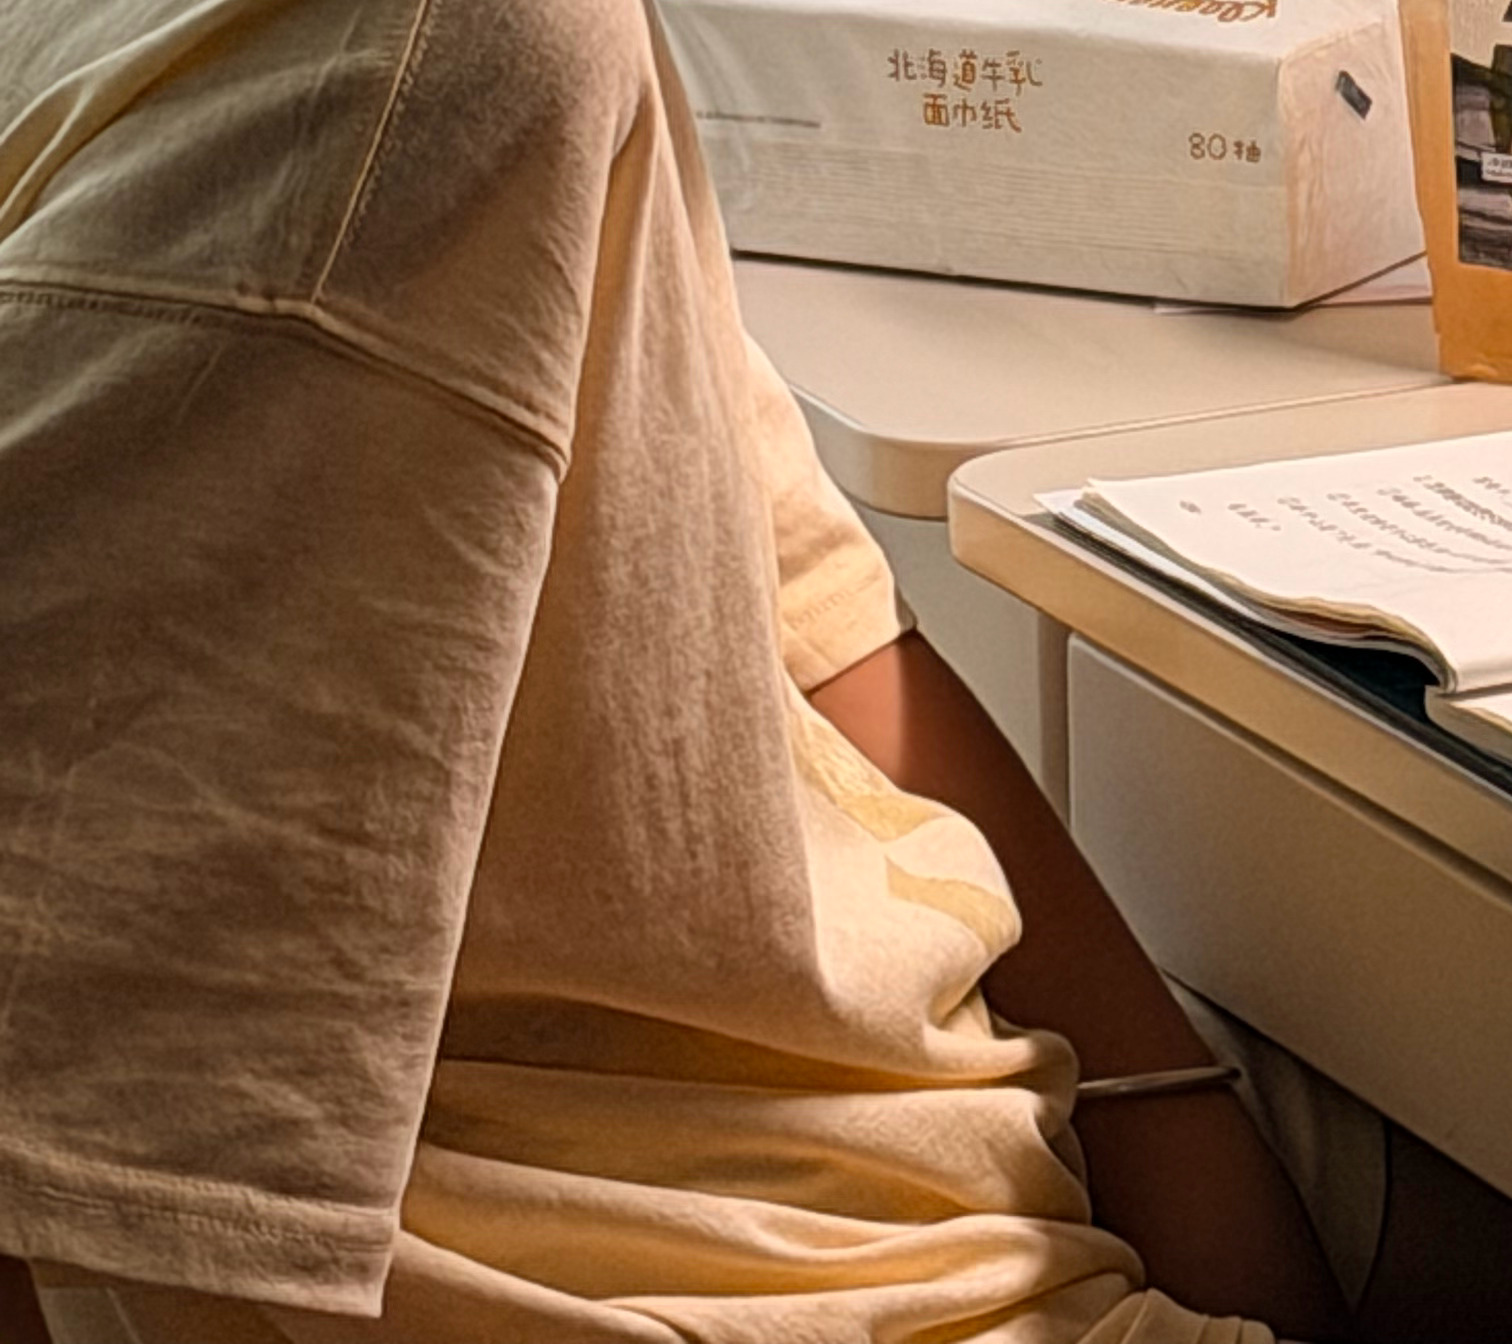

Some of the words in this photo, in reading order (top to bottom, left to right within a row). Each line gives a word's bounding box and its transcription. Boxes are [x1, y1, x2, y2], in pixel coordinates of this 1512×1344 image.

[887, 47, 1044, 96] 北海道牛乳
[922, 92, 1022, 133] 面巾纸
